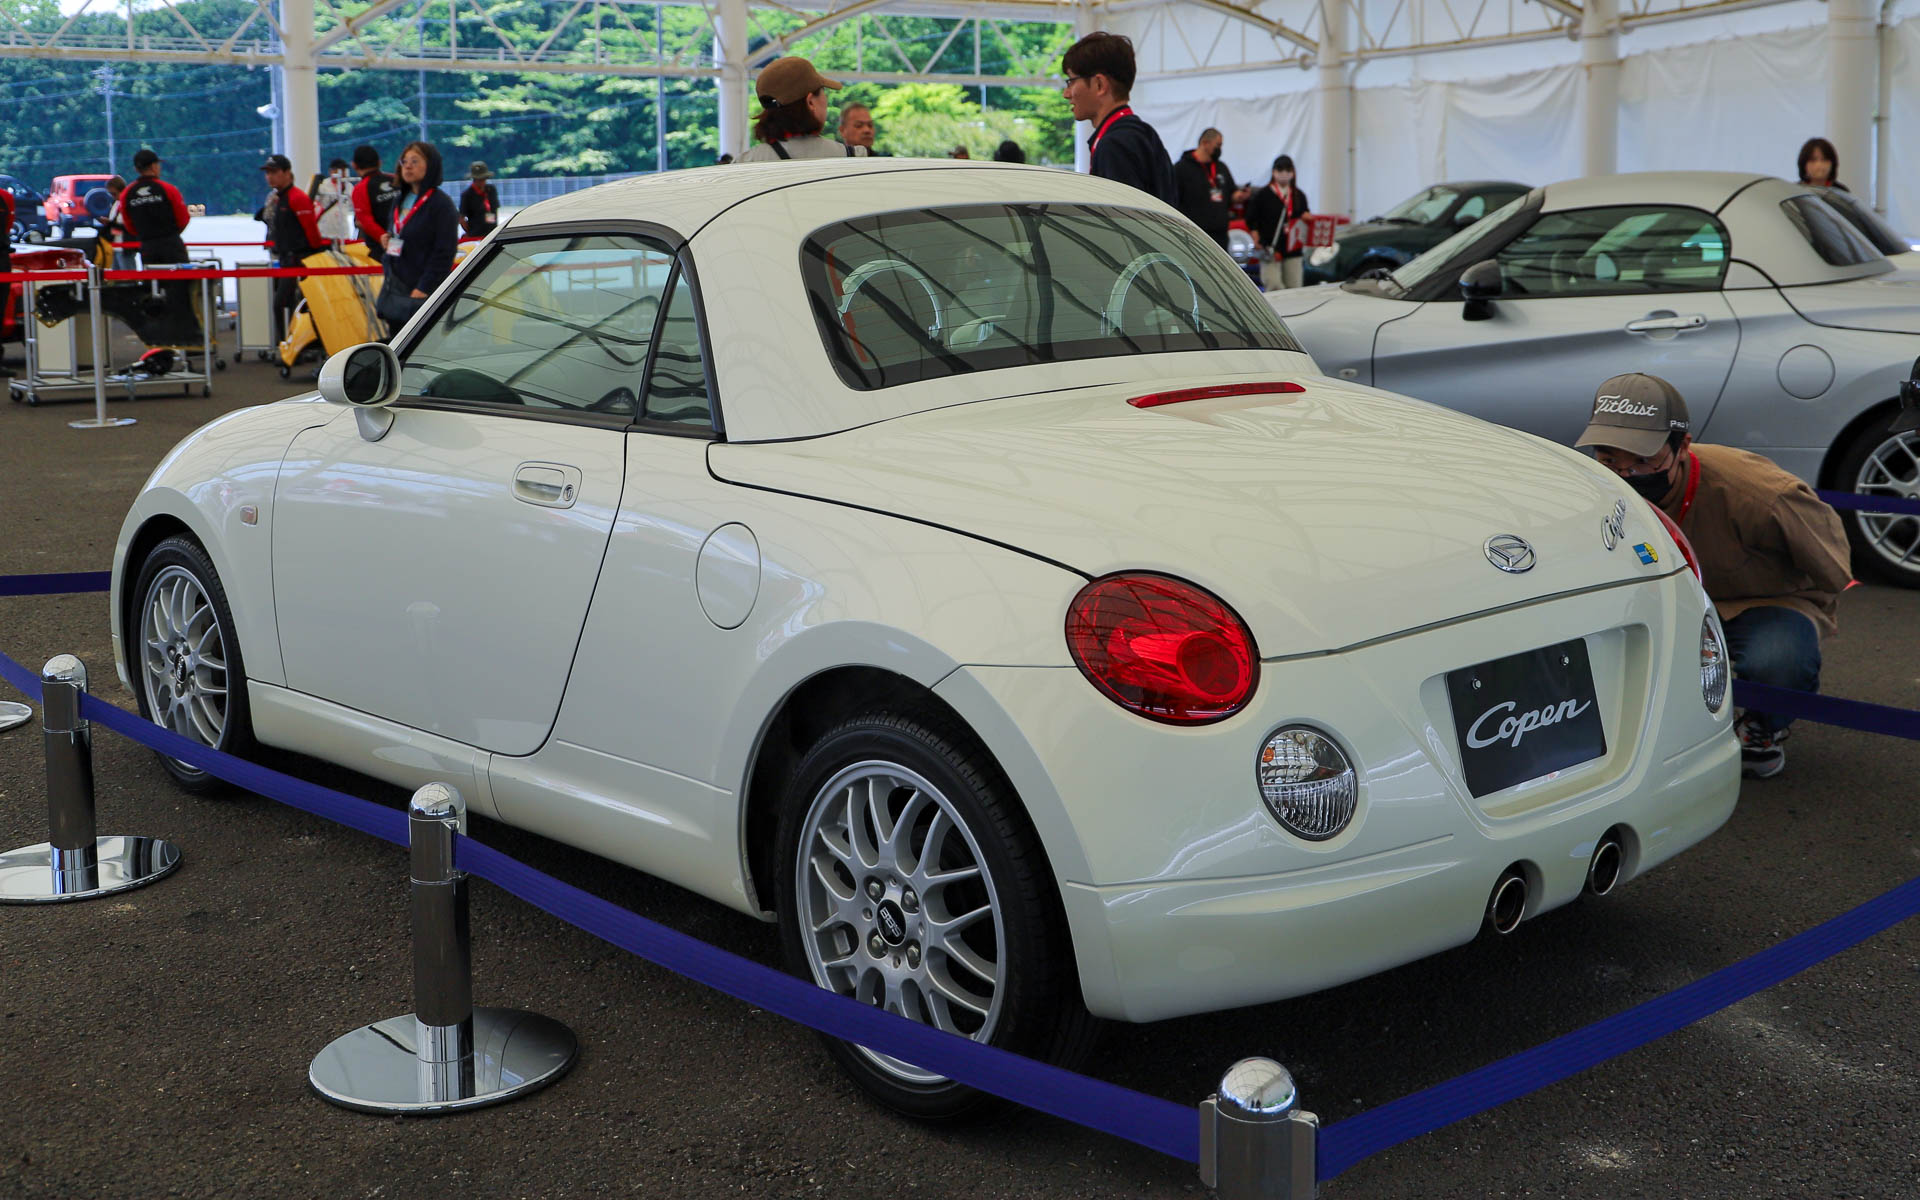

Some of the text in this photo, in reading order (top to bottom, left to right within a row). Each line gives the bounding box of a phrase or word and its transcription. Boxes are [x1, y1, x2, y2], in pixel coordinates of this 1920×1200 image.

[130, 195, 163, 207] COPEN
[1594, 394, 1658, 417] Titleist
[1466, 698, 1592, 749] Copen
[879, 906, 903, 938] BBS
